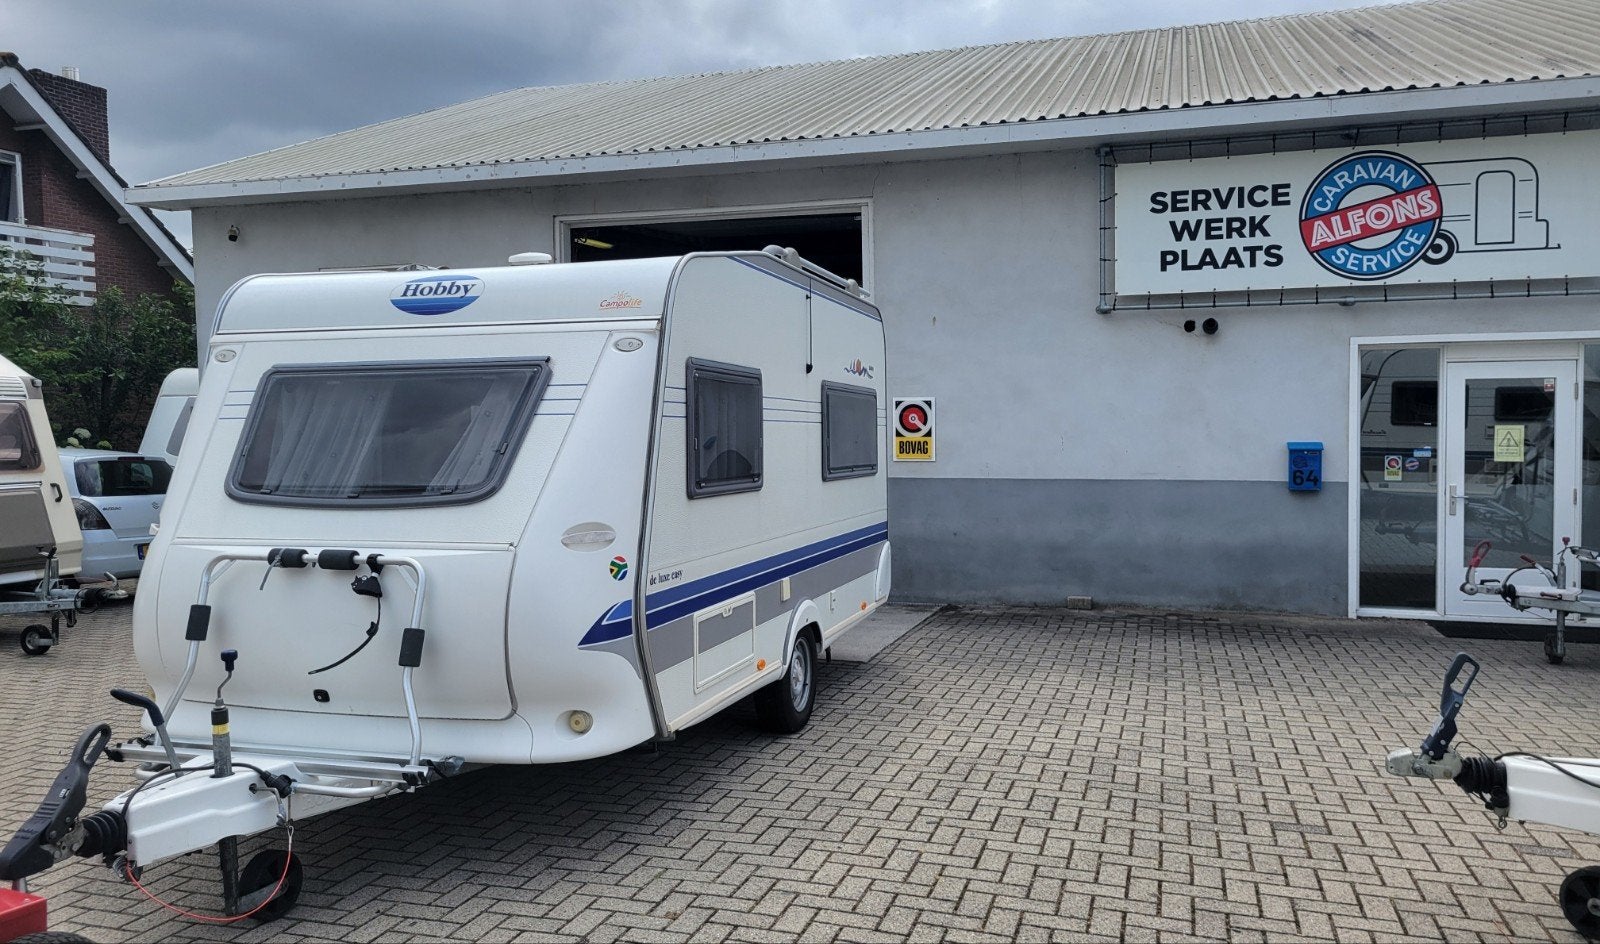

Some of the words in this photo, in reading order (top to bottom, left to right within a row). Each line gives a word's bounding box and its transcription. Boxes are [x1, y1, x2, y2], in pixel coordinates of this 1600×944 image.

[1150, 183, 1291, 214] SERVICE
[1313, 162, 1416, 212] CARAVAN
[1169, 215, 1271, 242] WERK
[1310, 190, 1438, 247] ALFONS
[1160, 244, 1284, 272] PLAATS
[1331, 228, 1426, 272] SERVICE
[400, 281, 477, 299] Hobby
[600, 299, 642, 309] Campolife
[898, 440, 929, 455] BOVAG
[1292, 469, 1319, 486] 64
